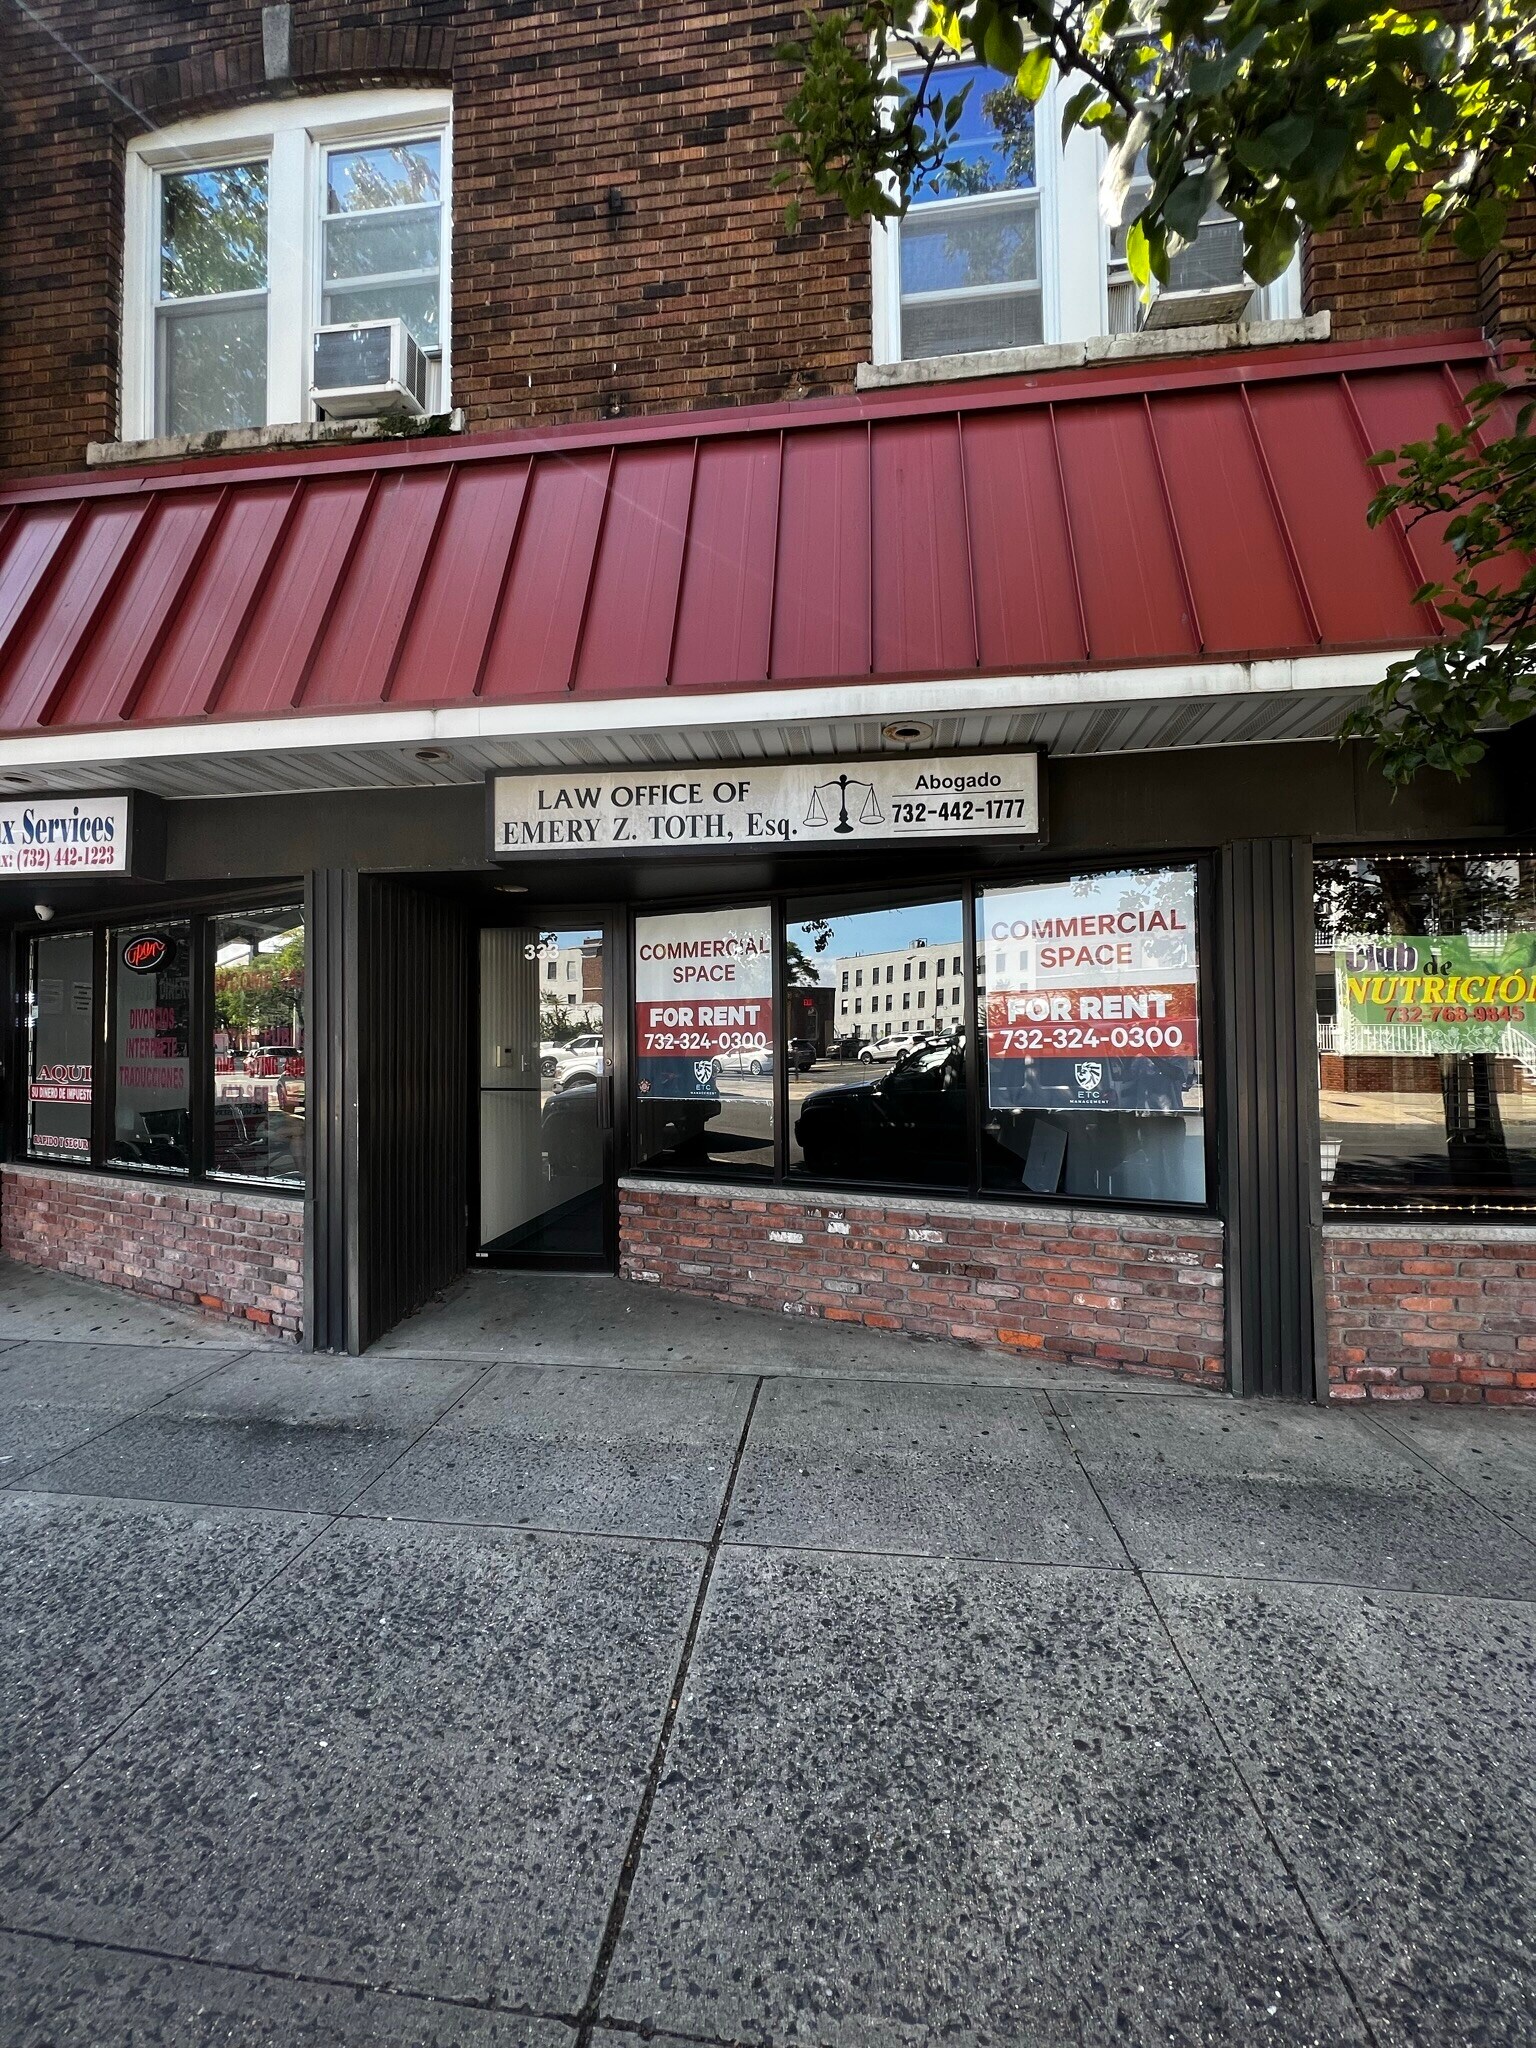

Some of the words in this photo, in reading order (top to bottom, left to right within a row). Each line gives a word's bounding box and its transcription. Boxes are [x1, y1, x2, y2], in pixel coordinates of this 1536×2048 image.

[914, 771, 1002, 793] Abogado
[537, 786, 602, 811] LAW
[610, 782, 704, 807] OFFICE
[712, 781, 751, 803] OF
[891, 799, 1025, 824] 732-442-1777
[0, 819, 15, 845] x
[22, 806, 115, 845] Services
[502, 816, 601, 845] EMERY
[612, 816, 638, 842] Z.
[647, 813, 734, 842] TOTH,
[745, 811, 798, 840] Esq.
[17, 848, 51, 872] (732)
[54, 845, 115, 866] 442-1223
[991, 909, 1188, 942] COMMERCIAL
[523, 944, 559, 961] 333
[639, 935, 771, 962] COMMERCIAL
[1040, 942, 1133, 968] SPACE
[1345, 942, 1419, 973] Club
[1423, 955, 1452, 975] de
[673, 964, 736, 984] SPACE
[649, 1006, 695, 1028] FOR
[698, 1004, 761, 1026] RENT
[1007, 997, 1073, 1024] FOR
[1079, 993, 1173, 1020] RENT
[1384, 1005, 1526, 1023] 732-768-9845
[644, 1031, 767, 1050] 732-324-0300
[1000, 1025, 1183, 1050] 732-324-0300
[36, 1064, 92, 1085] AQUI
[119, 1066, 184, 1090] TRADUCCIONES
[1077, 1090, 1100, 1099] ETC
[64, 1138, 90, 1151] SEGUR
